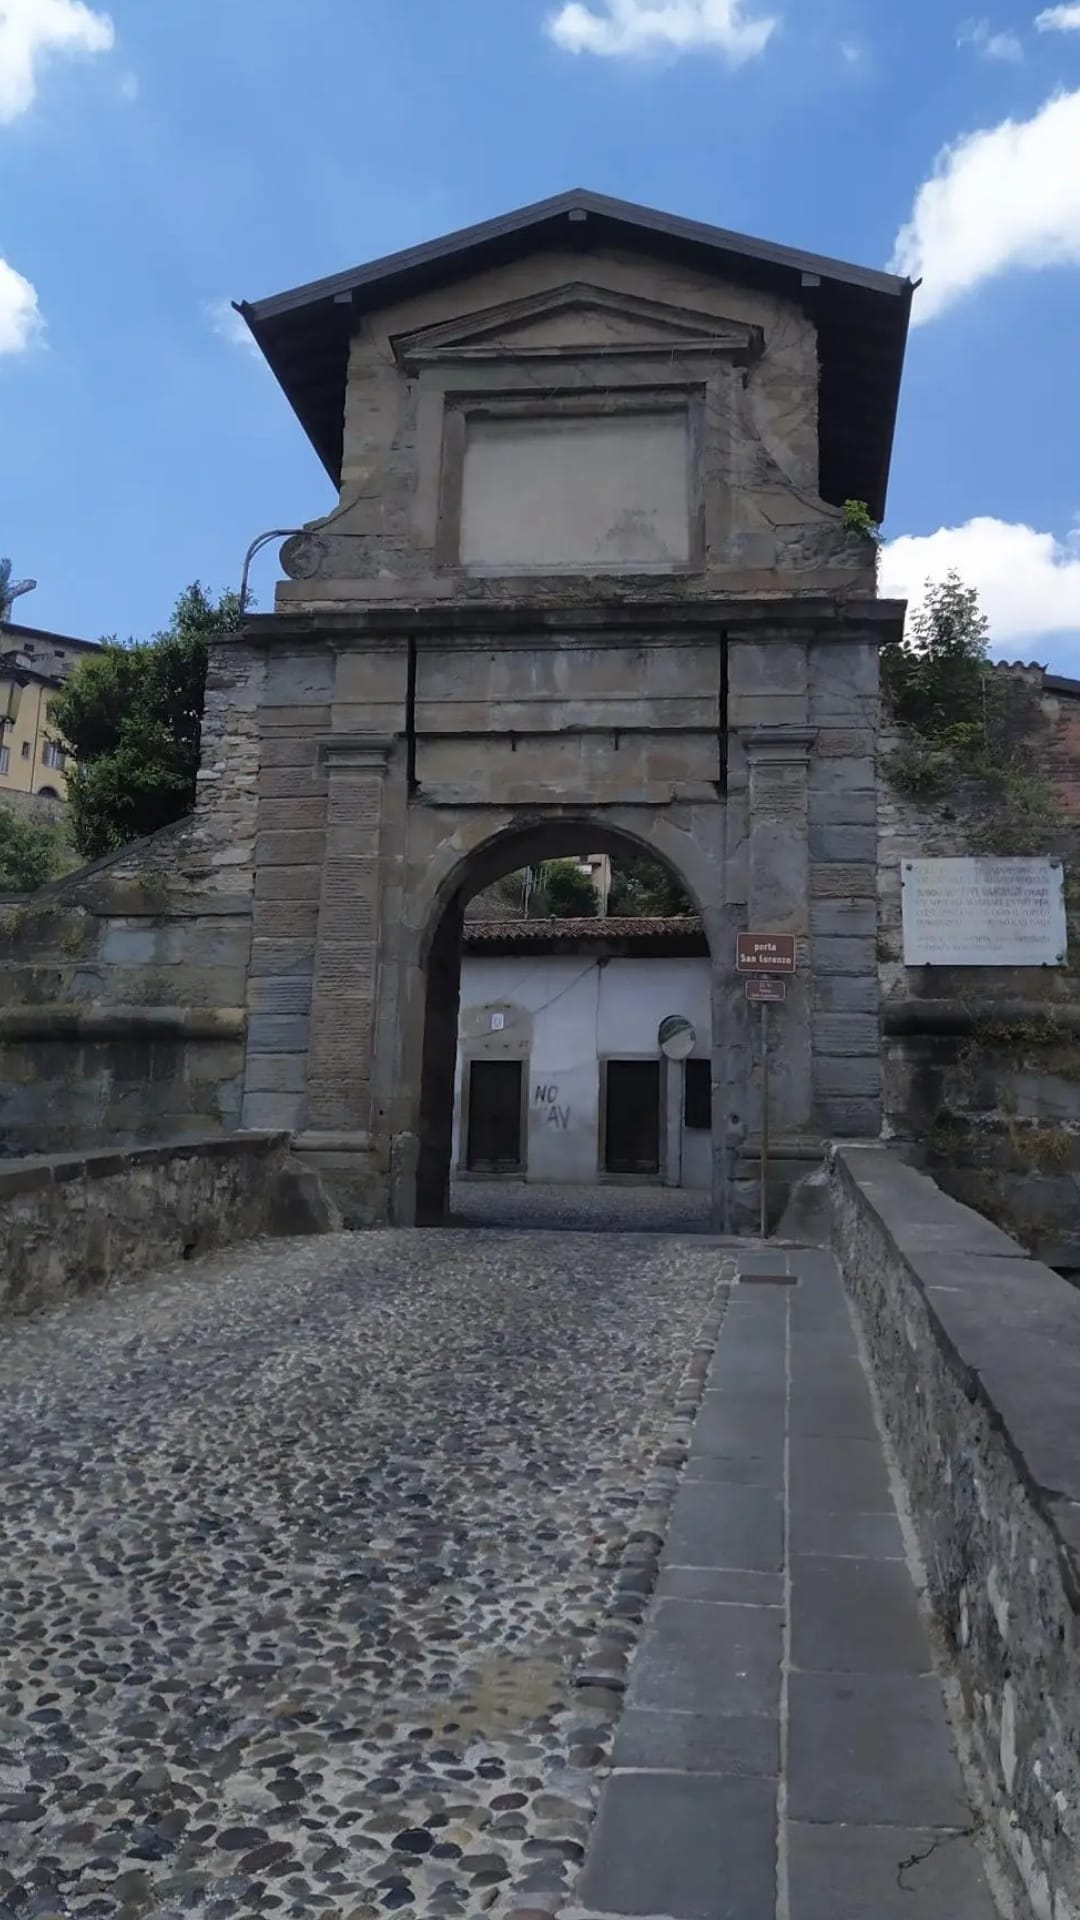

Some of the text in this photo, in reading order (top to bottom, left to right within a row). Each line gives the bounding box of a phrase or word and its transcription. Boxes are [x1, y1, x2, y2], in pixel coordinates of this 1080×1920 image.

[754, 943, 776, 952] porta
[740, 953, 791, 964] San Lorenzo
[534, 1085, 558, 1104] NO
